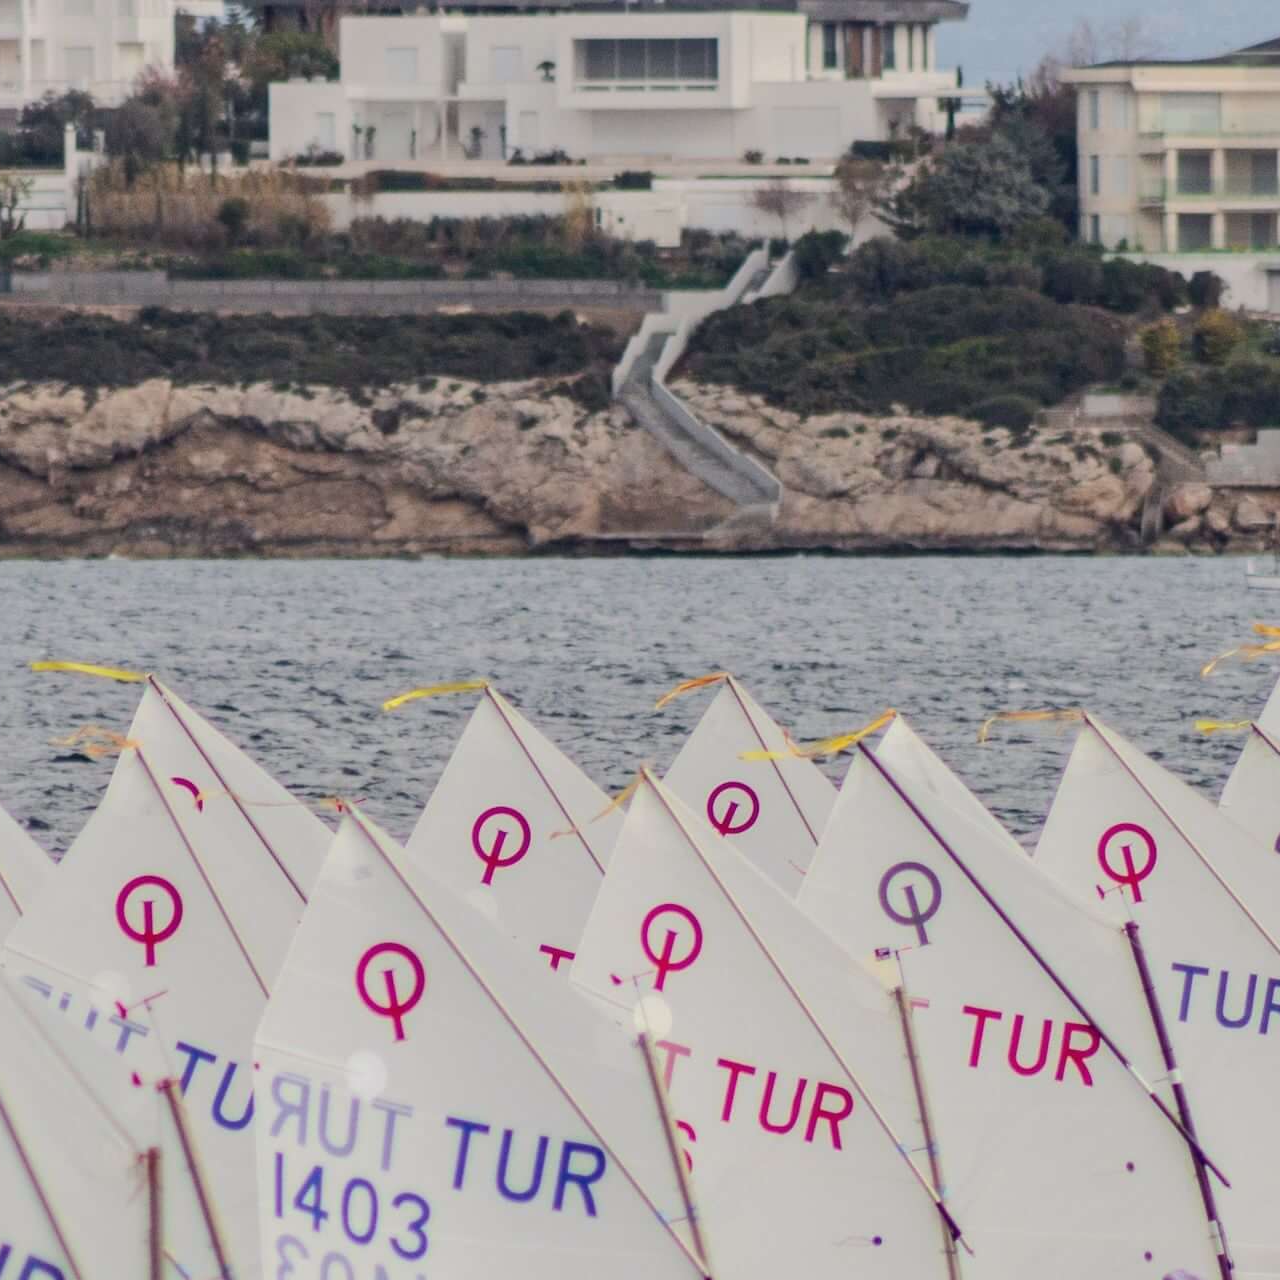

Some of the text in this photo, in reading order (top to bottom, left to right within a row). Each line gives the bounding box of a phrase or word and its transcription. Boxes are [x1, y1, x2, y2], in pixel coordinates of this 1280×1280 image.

[962, 1005, 1101, 1087] TUR
[716, 1058, 855, 1152] TUR
[273, 1152, 432, 1261] 1403
[445, 1116, 607, 1218] TUR
